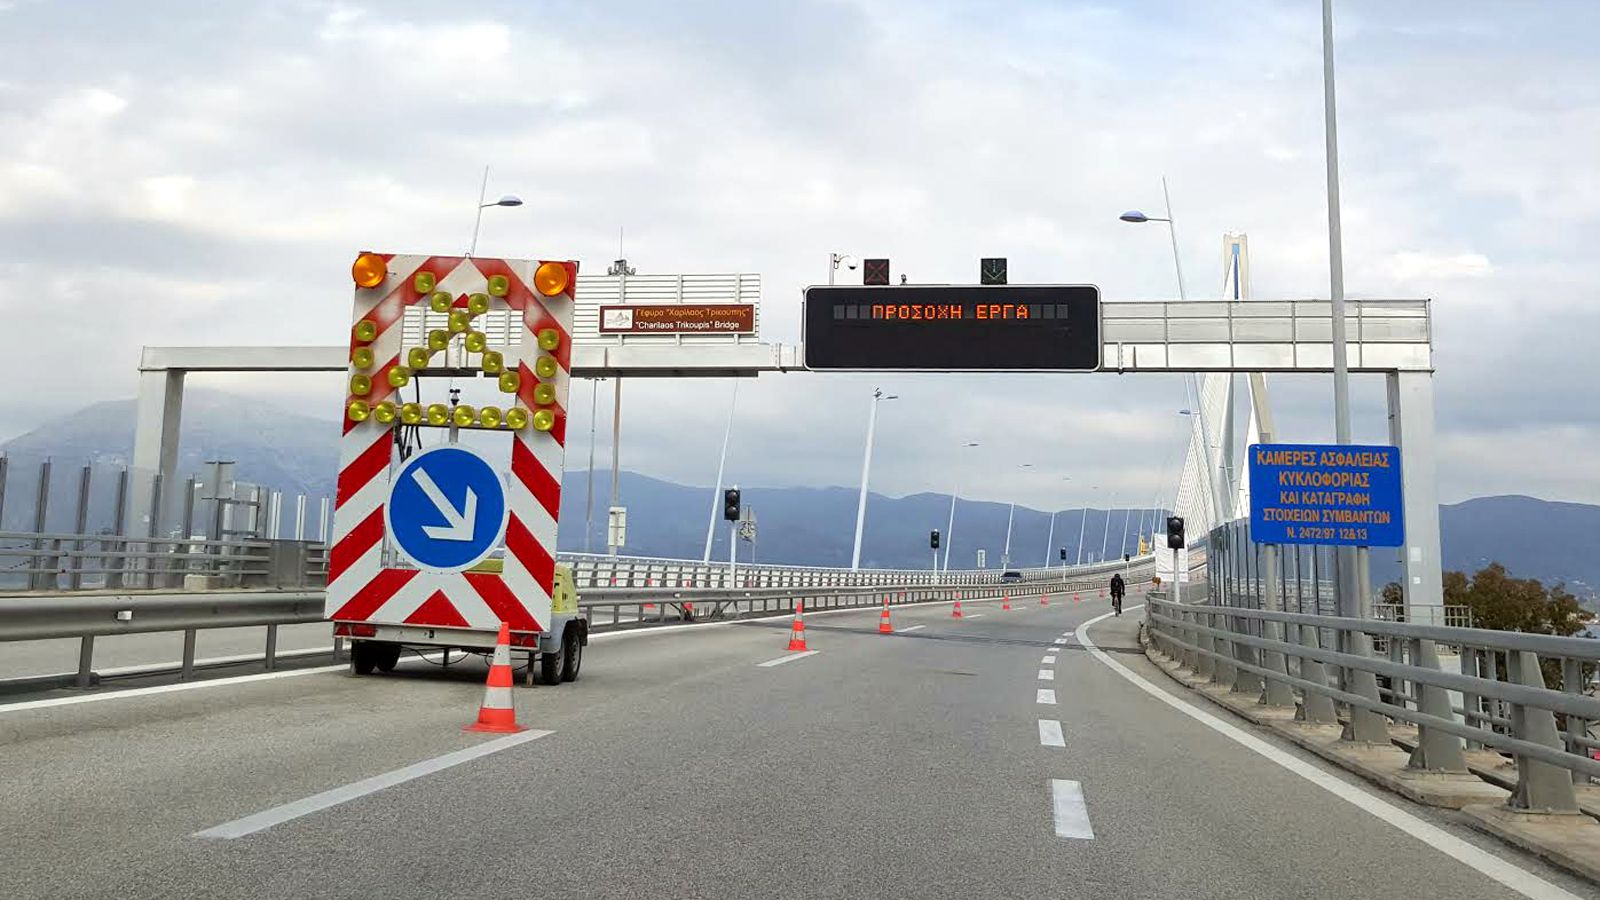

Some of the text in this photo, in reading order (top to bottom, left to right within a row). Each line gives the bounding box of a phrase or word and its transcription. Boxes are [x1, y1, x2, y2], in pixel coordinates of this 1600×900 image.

[872, 304, 1029, 320] ΠΡΟΣΟΧΗ ΕΡΓΑ
[714, 320, 740, 330] Bridge
[1257, 450, 1390, 467] ΚΑΜΕΡΕΣ ΑΣΦΑΛΕΙΑΣ
[1279, 471, 1370, 487] ΚΥΚΛΟΦΟΡΙΑΣ
[1279, 491, 1370, 506] ΚΑΙ ΚΑΤΑΓΡΑΦΗ
[1263, 508, 1390, 524] ΣΤΟΙΧΕΙΩΝ ΣΥΜΒΑΝΤΩΝ
